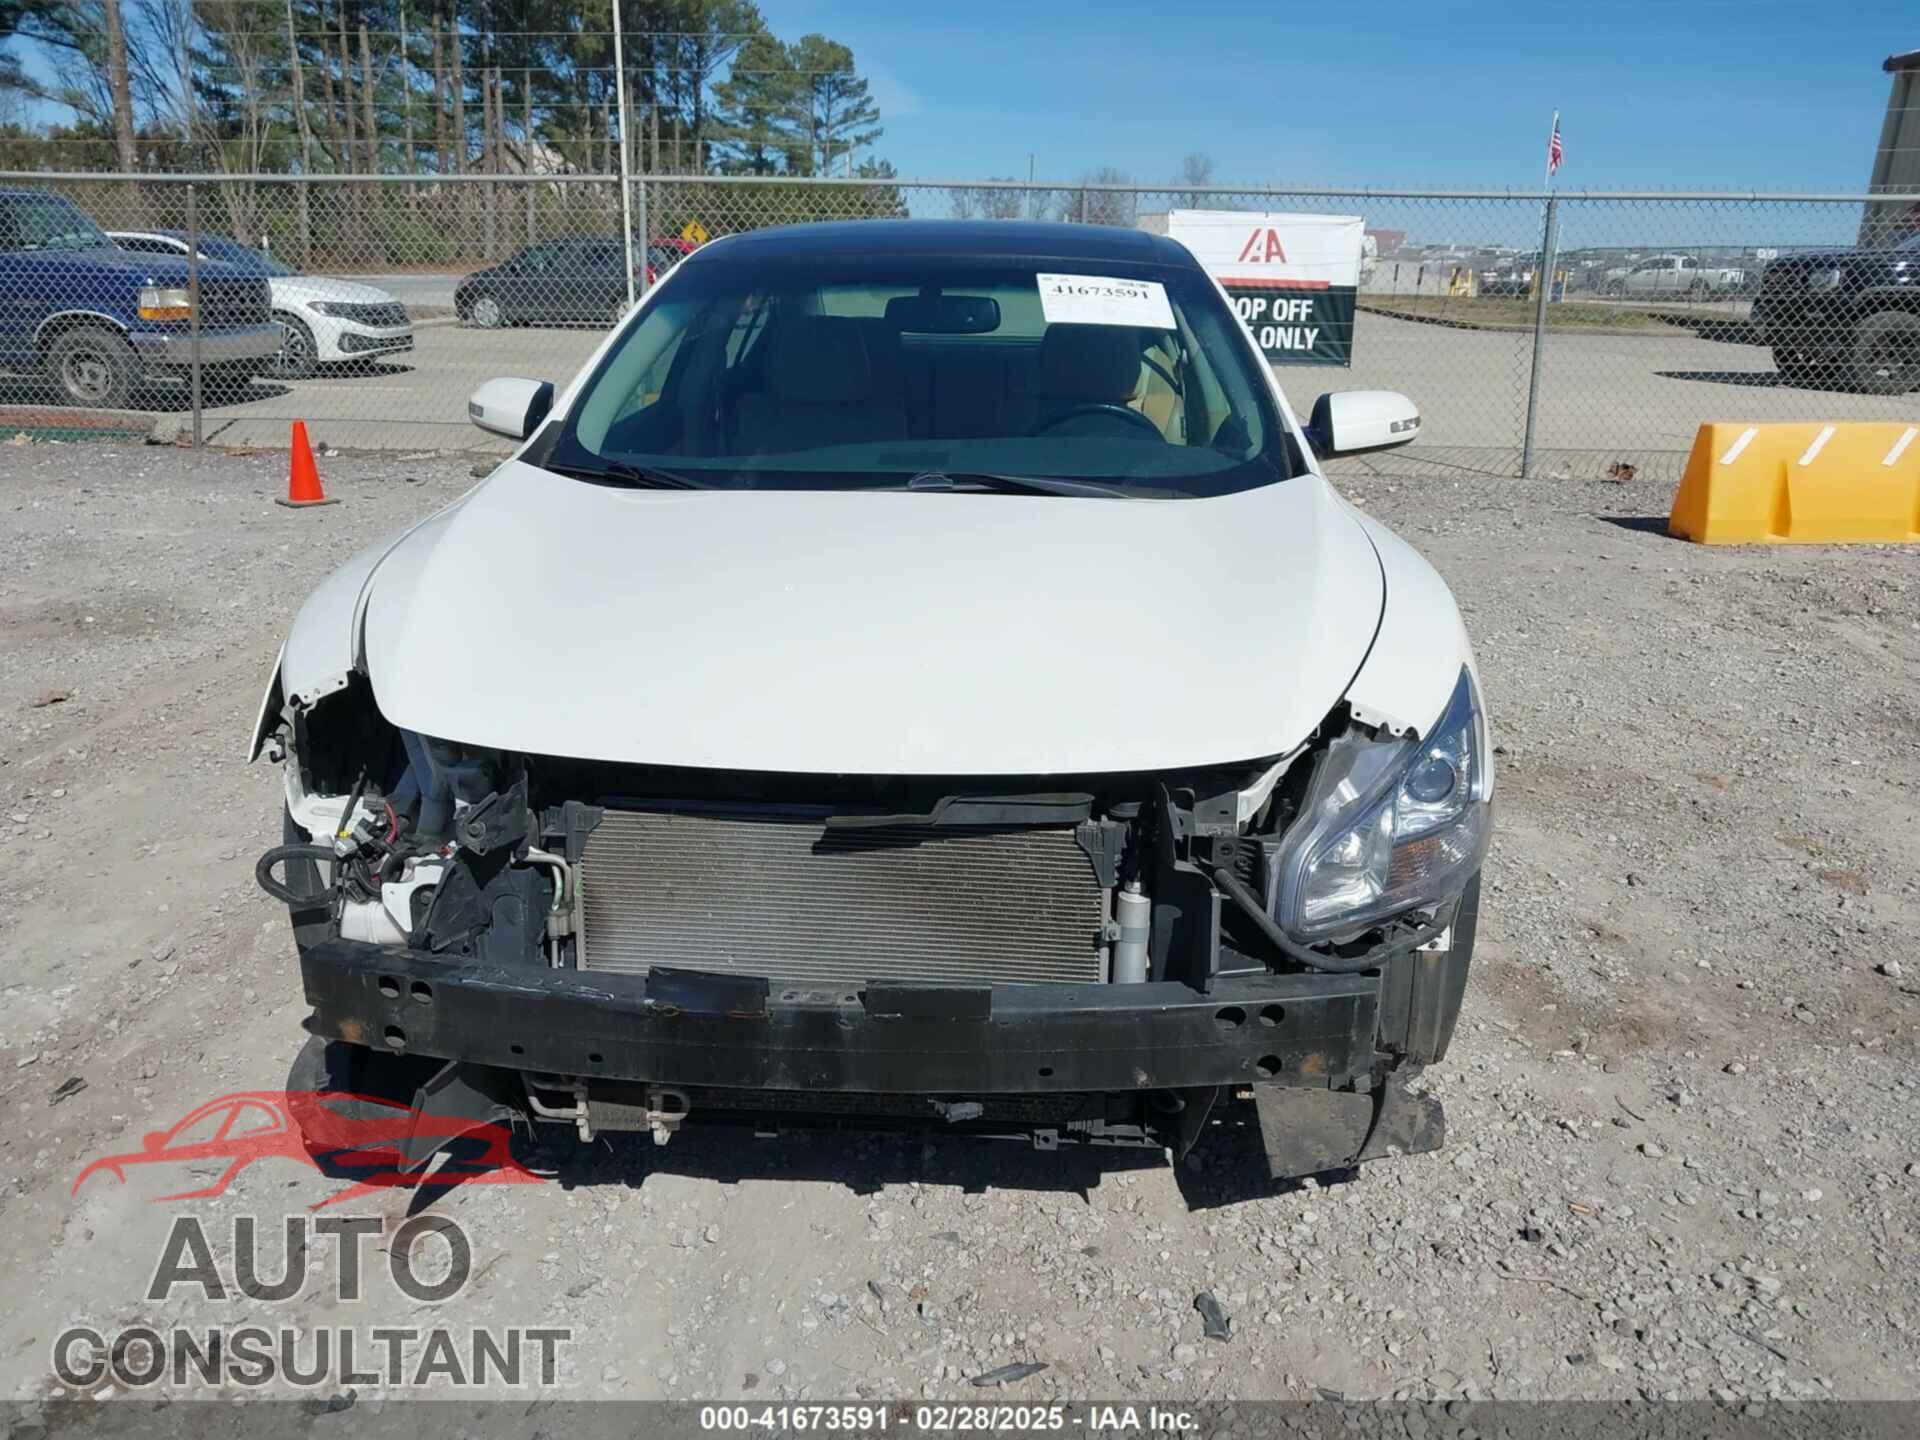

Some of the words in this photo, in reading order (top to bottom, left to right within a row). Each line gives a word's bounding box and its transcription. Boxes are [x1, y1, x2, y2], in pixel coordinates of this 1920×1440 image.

[1053, 285, 1149, 299] 41673591
[1272, 298, 1313, 321] OFF
[1260, 326, 1319, 350] ONLY
